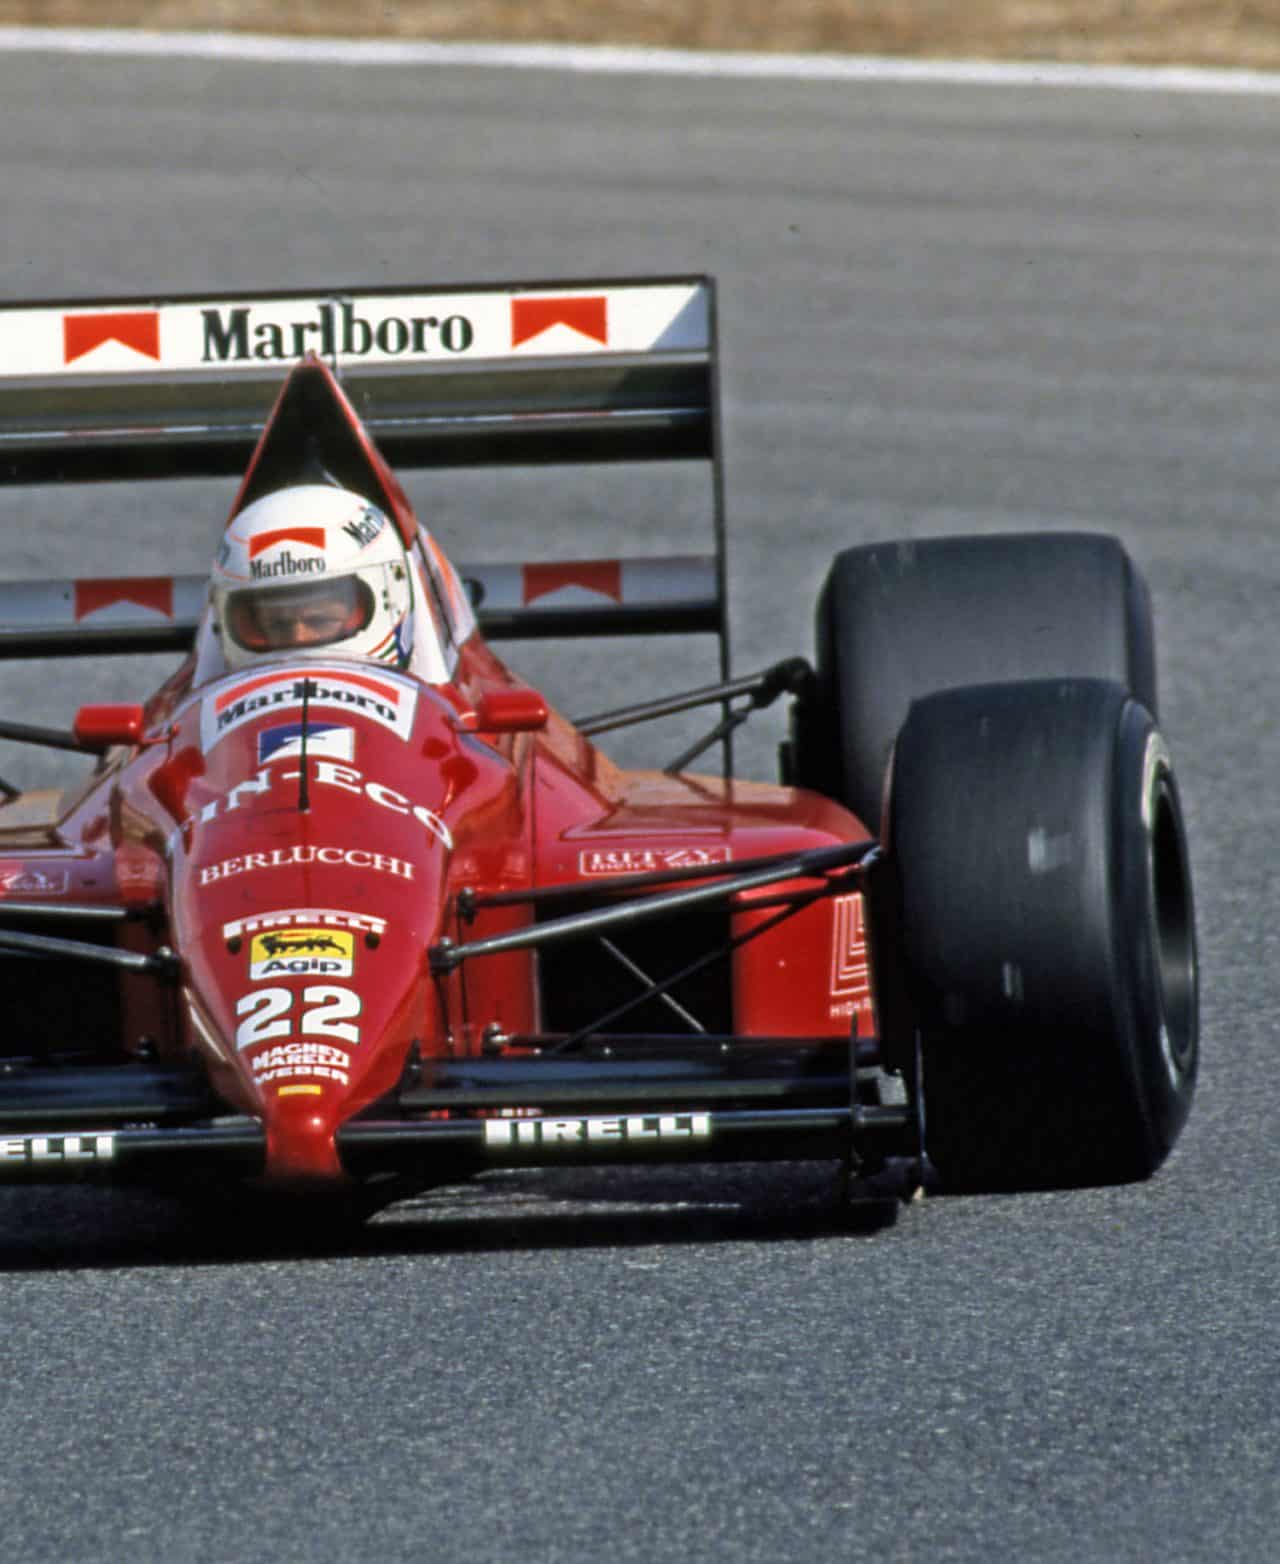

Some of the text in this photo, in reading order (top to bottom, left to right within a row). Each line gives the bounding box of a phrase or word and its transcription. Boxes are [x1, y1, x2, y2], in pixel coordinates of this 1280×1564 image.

[200, 302, 474, 361] Marlboro
[250, 551, 326, 578] Marlboro
[218, 681, 396, 731] Marlboro
[200, 845, 415, 885] BERLUCCHI
[223, 908, 388, 939] PIRELLI
[262, 959, 342, 974] Agip
[236, 985, 362, 1051] 22
[254, 1066, 349, 1086] WEBER
[485, 1112, 710, 1145] PIRELLI
